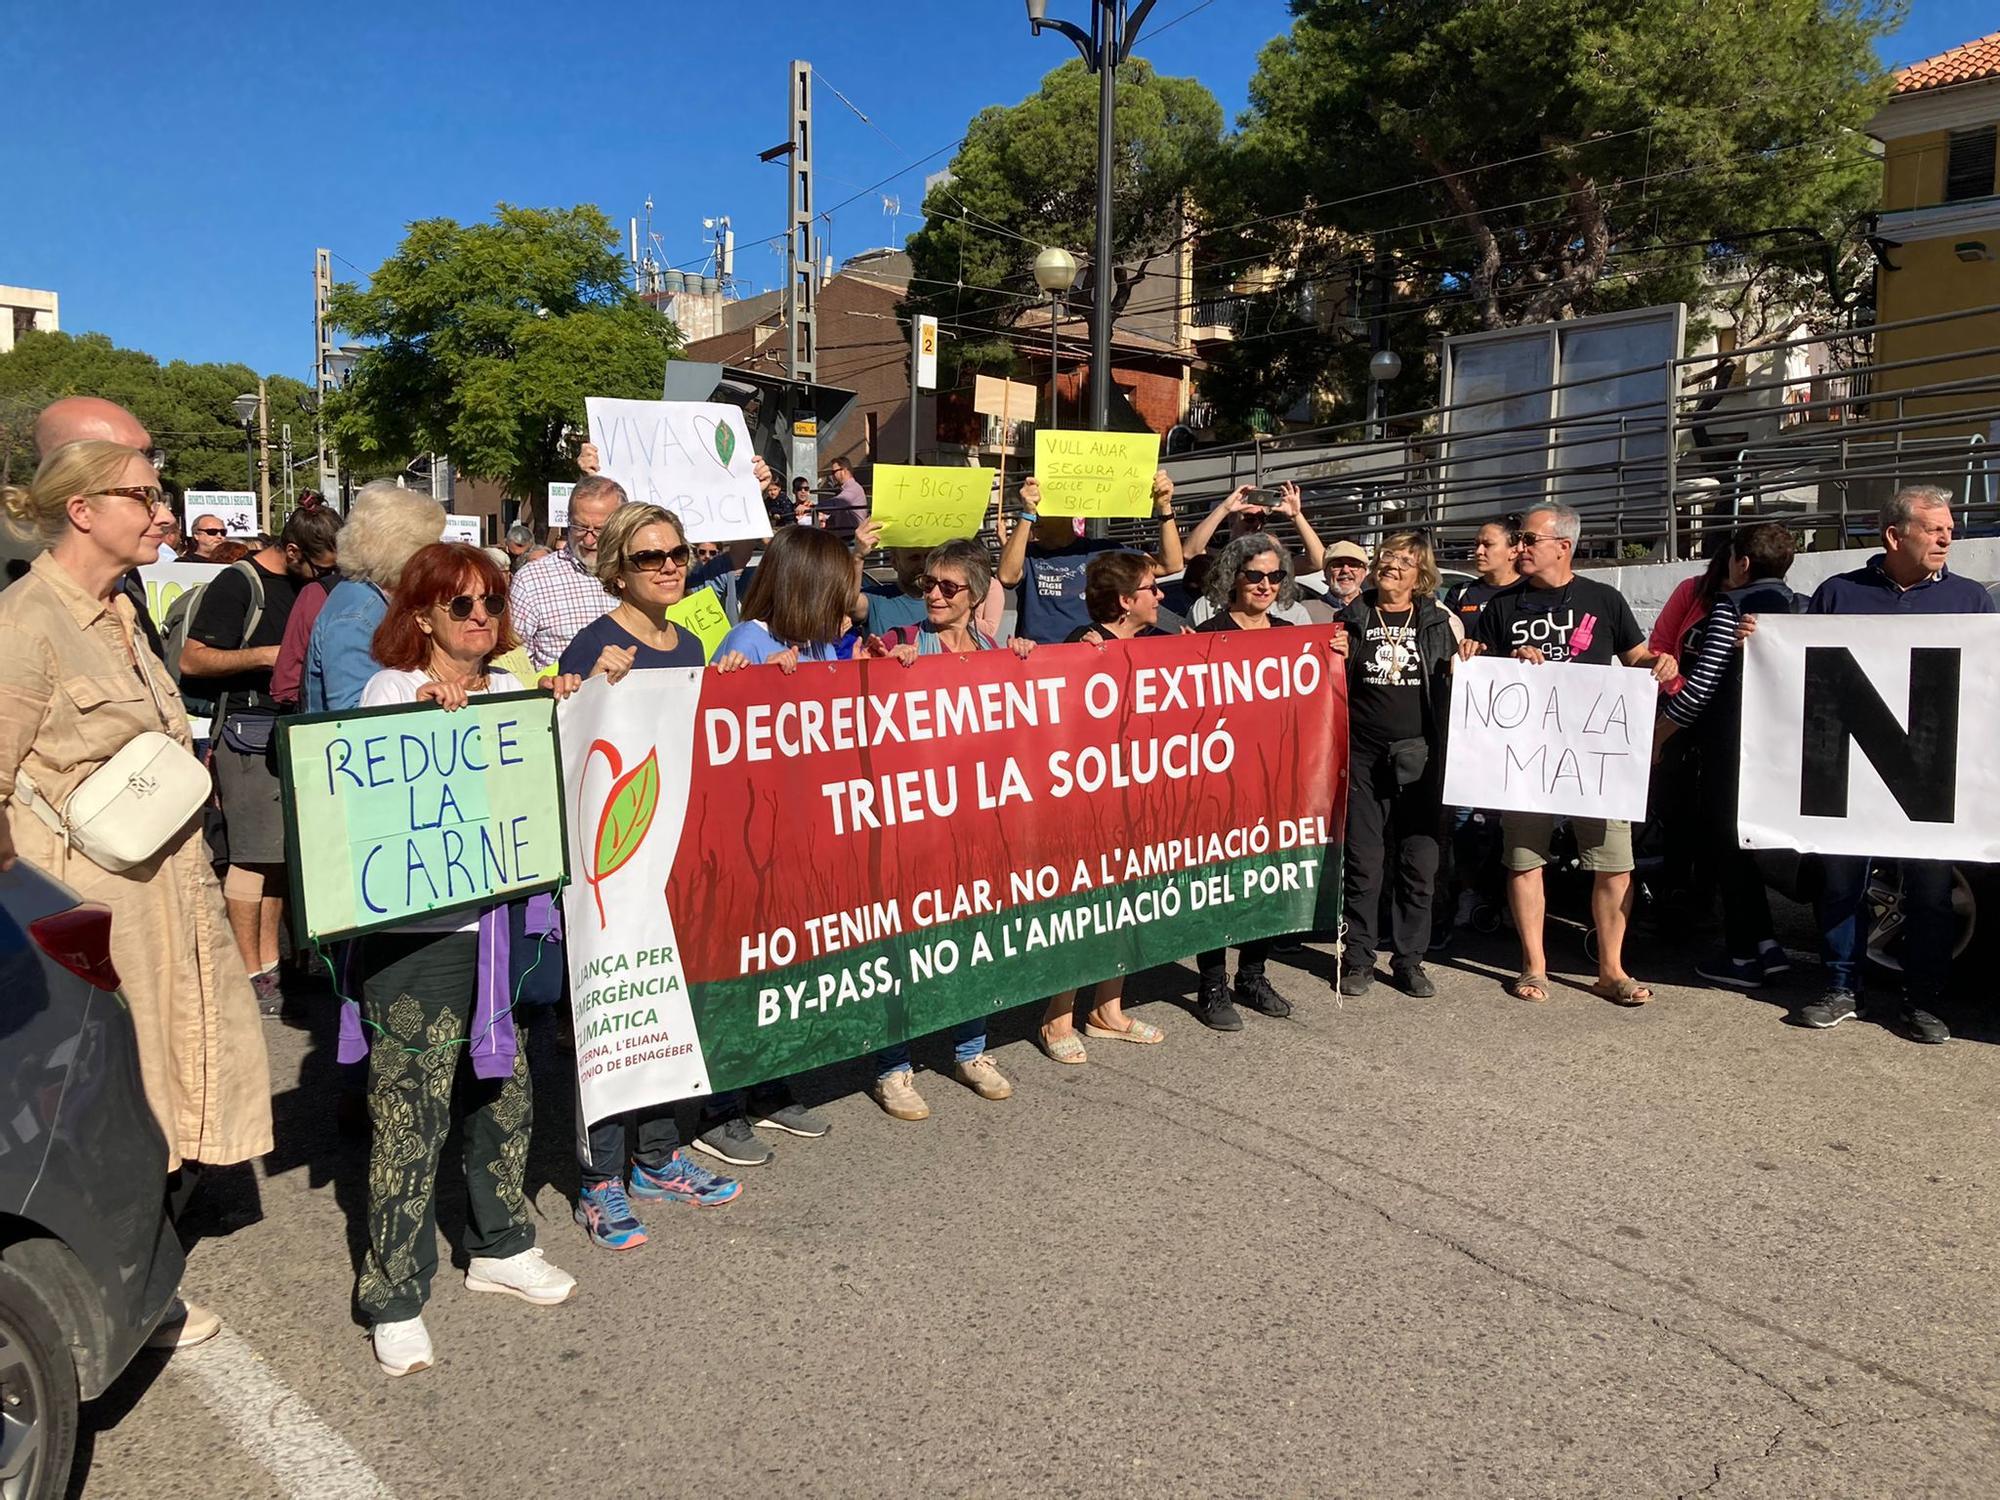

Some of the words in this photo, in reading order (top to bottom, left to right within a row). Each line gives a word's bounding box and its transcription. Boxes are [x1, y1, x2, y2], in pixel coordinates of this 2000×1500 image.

[925, 339, 932, 352] 2
[596, 415, 696, 468] VIVA
[1046, 439, 1084, 456] VULL
[1090, 441, 1128, 460] ANAR
[1047, 462, 1115, 477] SEGURA
[1123, 465, 1140, 478] AL
[1096, 483, 1112, 493] EN
[920, 477, 968, 501] BICIS
[1064, 495, 1102, 511] BICI
[668, 494, 752, 533] BICI
[904, 511, 967, 528] COTXES
[1037, 581, 1062, 590] HIGH
[1511, 609, 1574, 645] SOY
[704, 676, 1067, 766] DECREIXEMENT
[1084, 672, 1119, 719] O
[1135, 642, 1321, 714] EXTINCIÓ
[1464, 679, 1530, 729] NO
[1542, 686, 1562, 733] A
[1582, 692, 1631, 745] LA
[1800, 647, 1962, 824] N
[325, 720, 523, 796] REDUCE
[821, 765, 958, 835] TRIEU
[975, 757, 1034, 811] LA
[1048, 718, 1235, 798] SOLUCIÓ
[1505, 744, 1629, 796] MAT
[409, 783, 464, 831] LA
[361, 816, 540, 914] CARNE
[739, 926, 797, 975] HO
[804, 898, 902, 957] TENIM
[912, 879, 1002, 927] CLAR,
[1010, 865, 1059, 905] NO
[1070, 858, 1093, 893] A
[1100, 816, 1270, 885] L'AMPLIACIÓ
[1278, 816, 1334, 850] DEL
[636, 946, 674, 968] PER
[757, 956, 902, 1027] BY-PASS,
[909, 939, 960, 983] NO
[970, 930, 994, 967] A
[1003, 878, 1181, 958] L'AMPLIACIÓ
[1190, 875, 1235, 911] DEL
[1243, 859, 1318, 899] PORT
[607, 1059, 622, 1072] DE
[625, 1042, 694, 1068] BENAGÉBER
[616, 1032, 669, 1052] L'ELIANA
